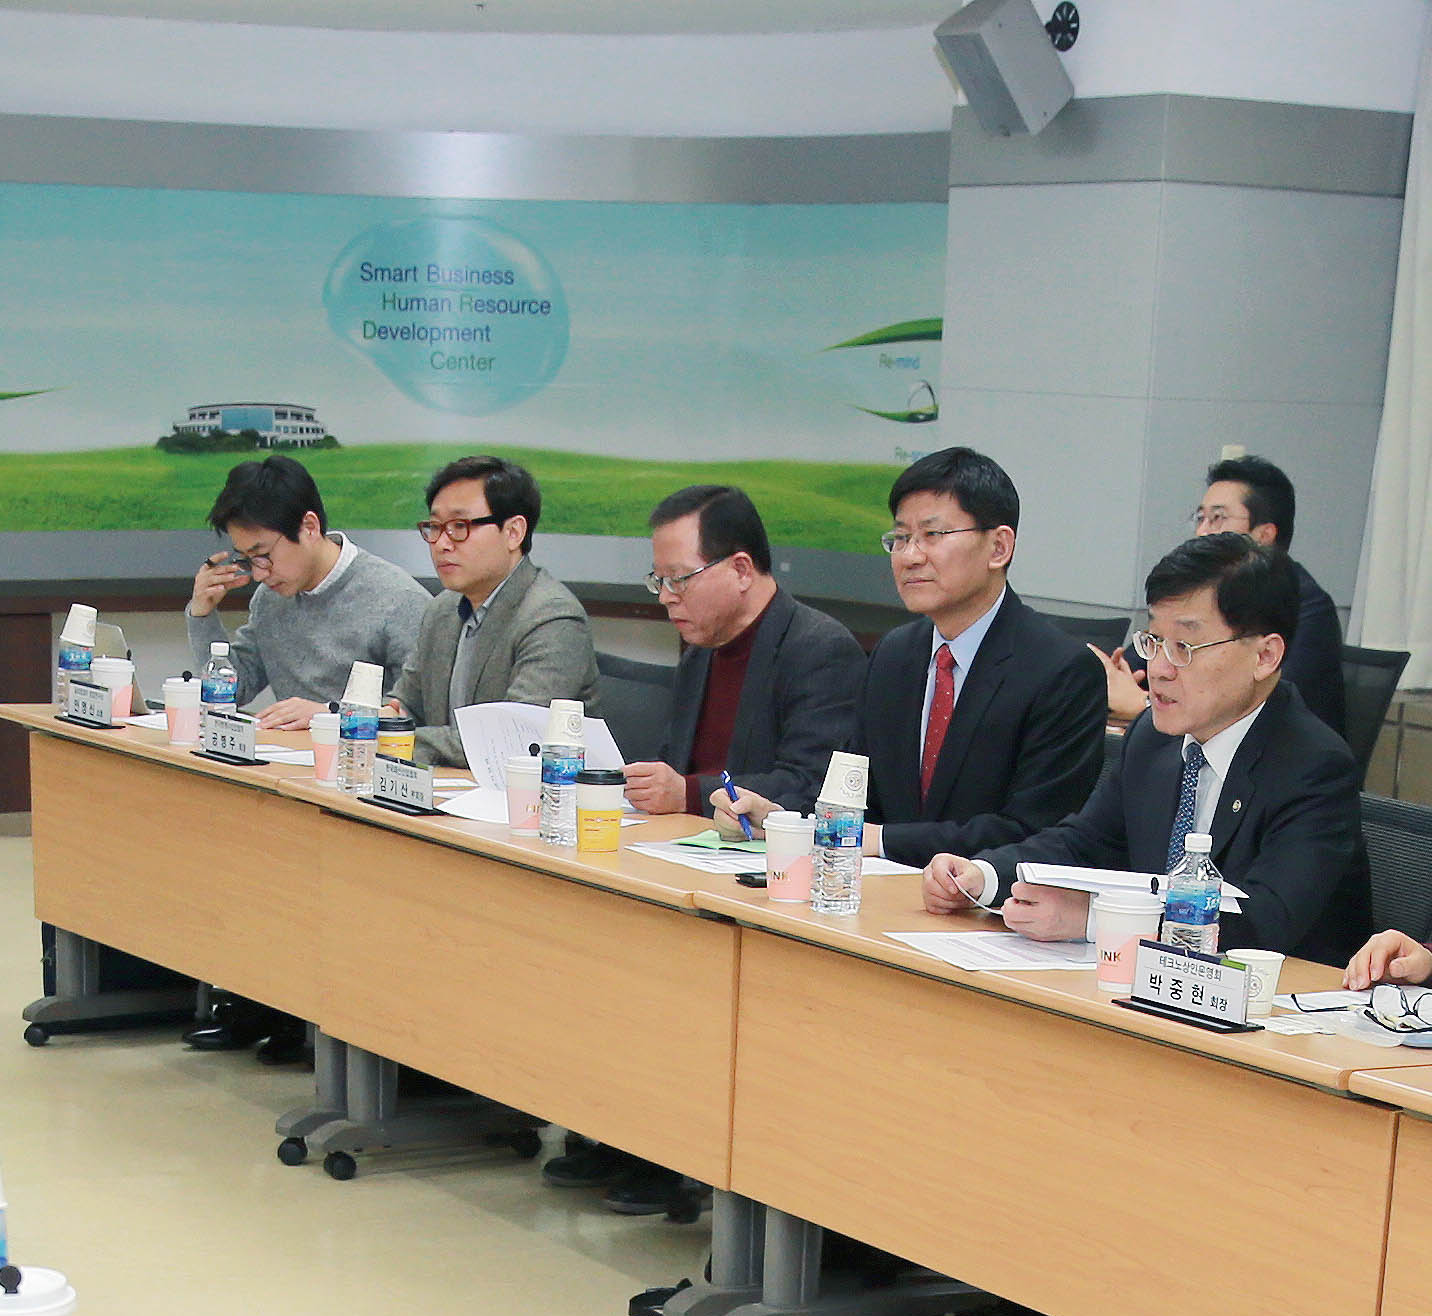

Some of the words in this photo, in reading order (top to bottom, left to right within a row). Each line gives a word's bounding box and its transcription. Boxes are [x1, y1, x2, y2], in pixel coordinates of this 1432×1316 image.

[360, 262, 418, 283] Smart
[427, 263, 515, 286] Business
[382, 292, 452, 313] Human
[459, 293, 552, 316] Resource
[362, 320, 492, 346] Development
[430, 351, 496, 372] Center
[1209, 995, 1228, 1012] 회장
